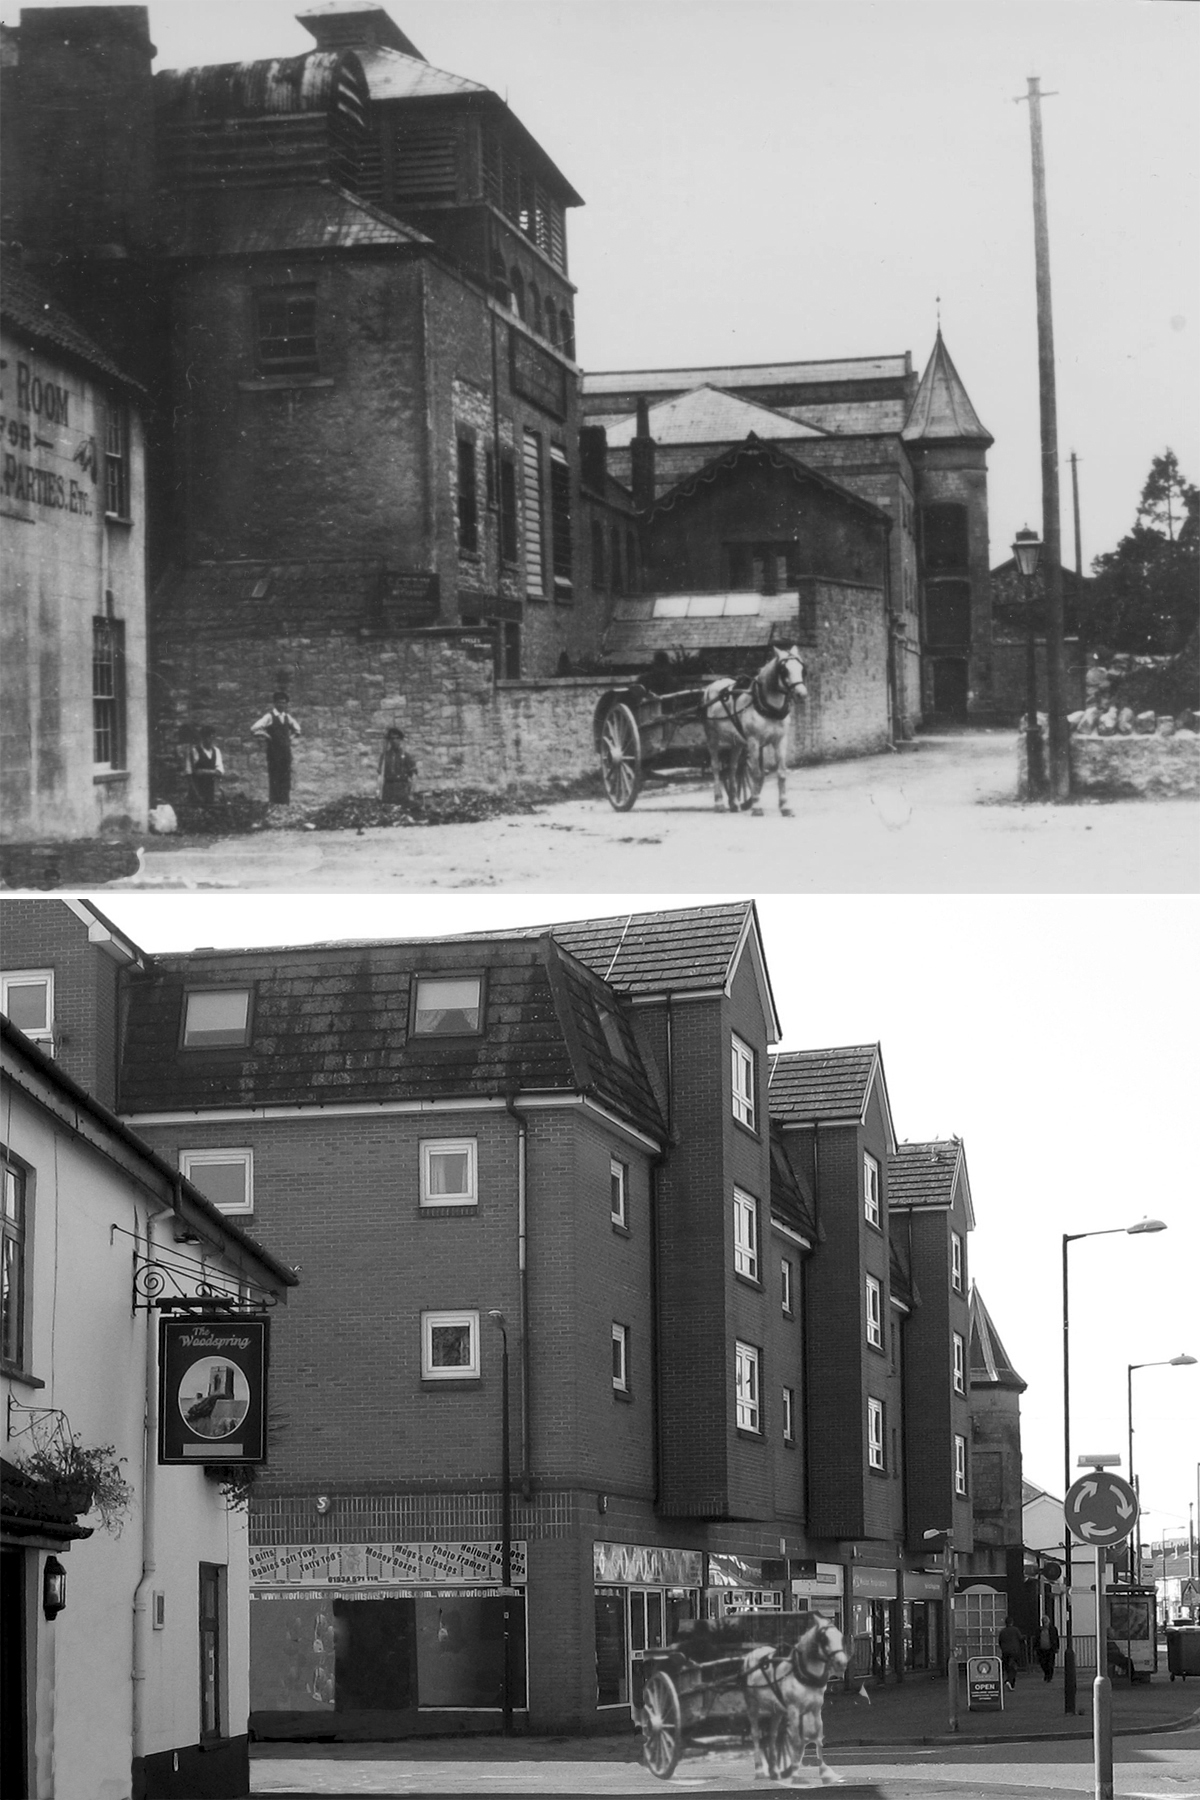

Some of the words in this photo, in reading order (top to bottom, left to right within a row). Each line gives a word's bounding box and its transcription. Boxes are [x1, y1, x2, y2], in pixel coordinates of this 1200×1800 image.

[193, 1326, 210, 1336] The
[179, 1334, 252, 1349] Woodspring
[254, 1549, 274, 1562] Gifts
[365, 1546, 392, 1564] Money
[393, 1557, 417, 1573] Boxes
[395, 1545, 417, 1559] Mugs
[418, 1554, 424, 1562] &
[425, 1556, 457, 1574] Glasses
[432, 1545, 455, 1560] Photo
[457, 1554, 486, 1572] Frames
[461, 1544, 489, 1560] Helium
[251, 1561, 279, 1577] Babies
[280, 1554, 297, 1567] Soft
[297, 1547, 317, 1559] Toys
[299, 1559, 320, 1572] Tatty
